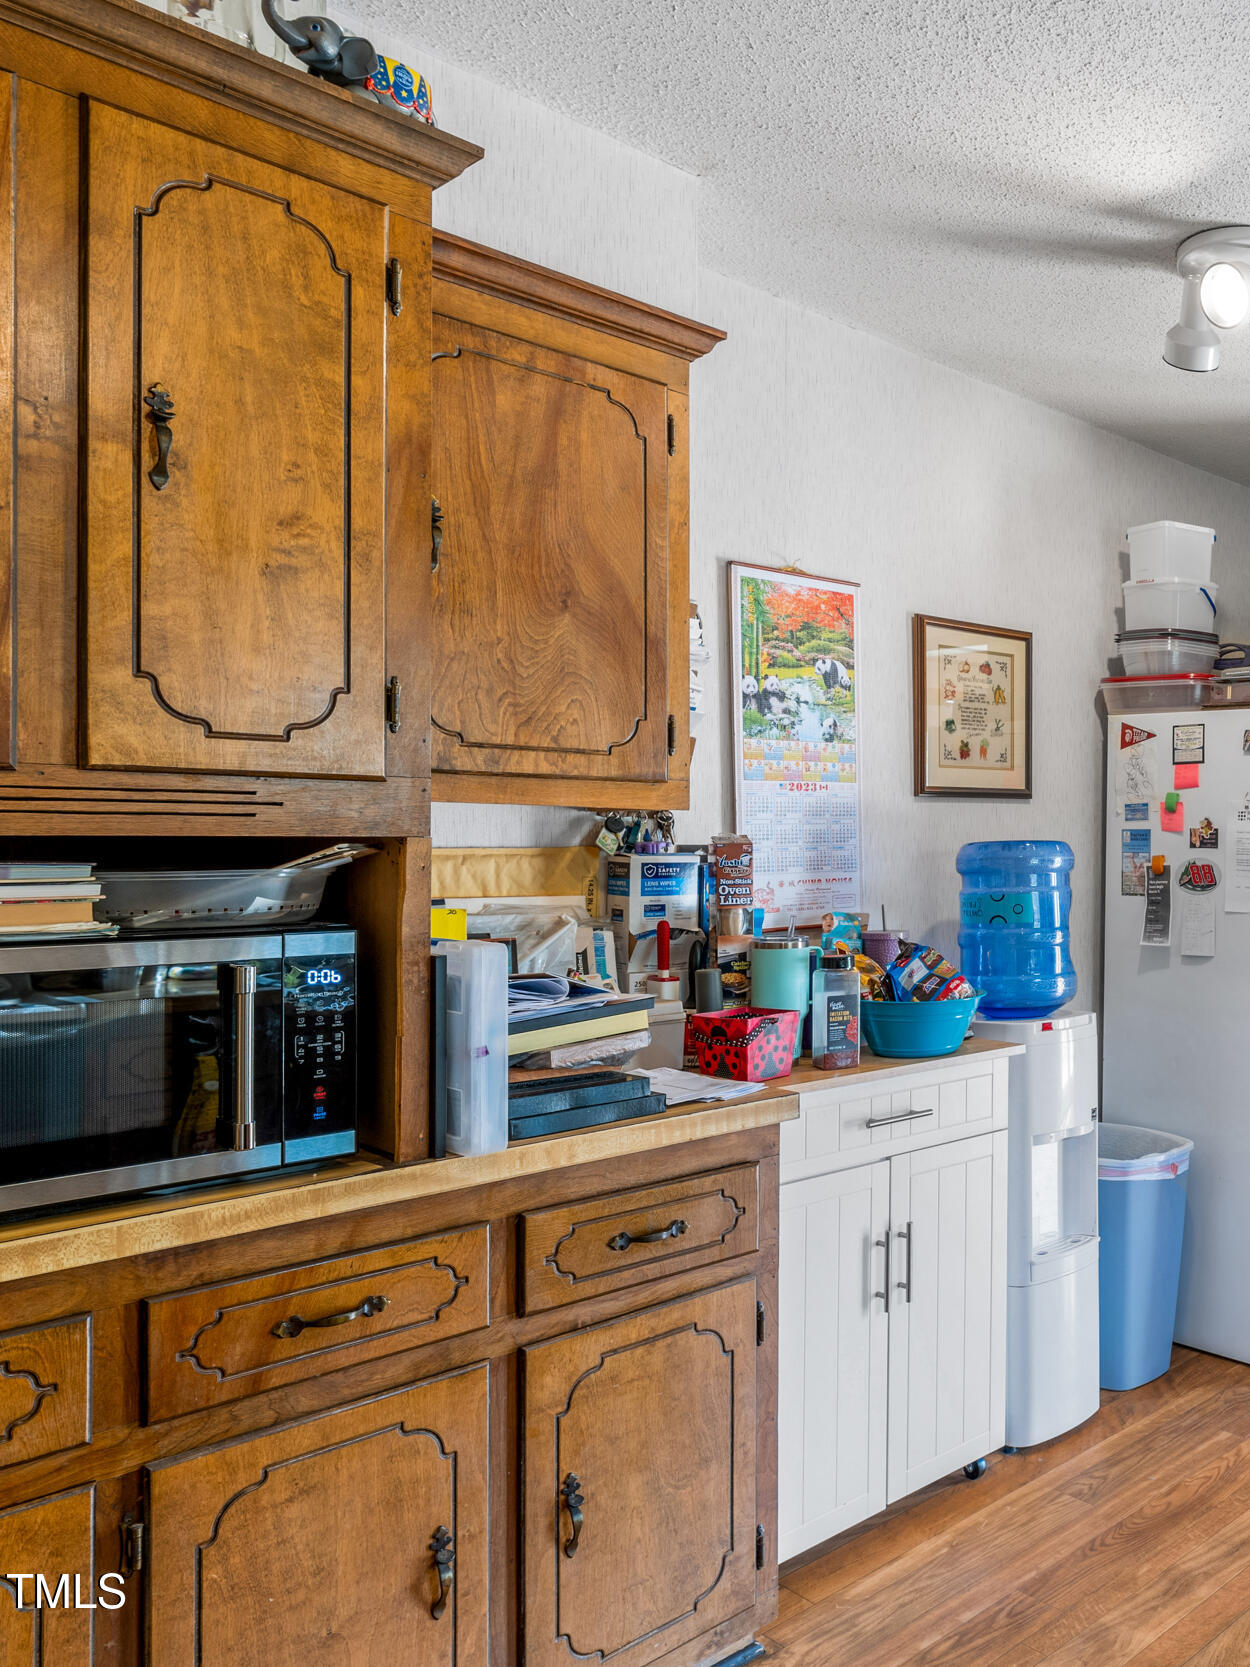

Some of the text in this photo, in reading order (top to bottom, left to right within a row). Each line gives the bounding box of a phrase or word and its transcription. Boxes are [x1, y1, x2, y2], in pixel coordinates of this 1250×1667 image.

[788, 782, 817, 791] 2023
[1189, 864, 1217, 885] 88
[718, 885, 751, 895] Oven
[719, 895, 753, 905] Liner
